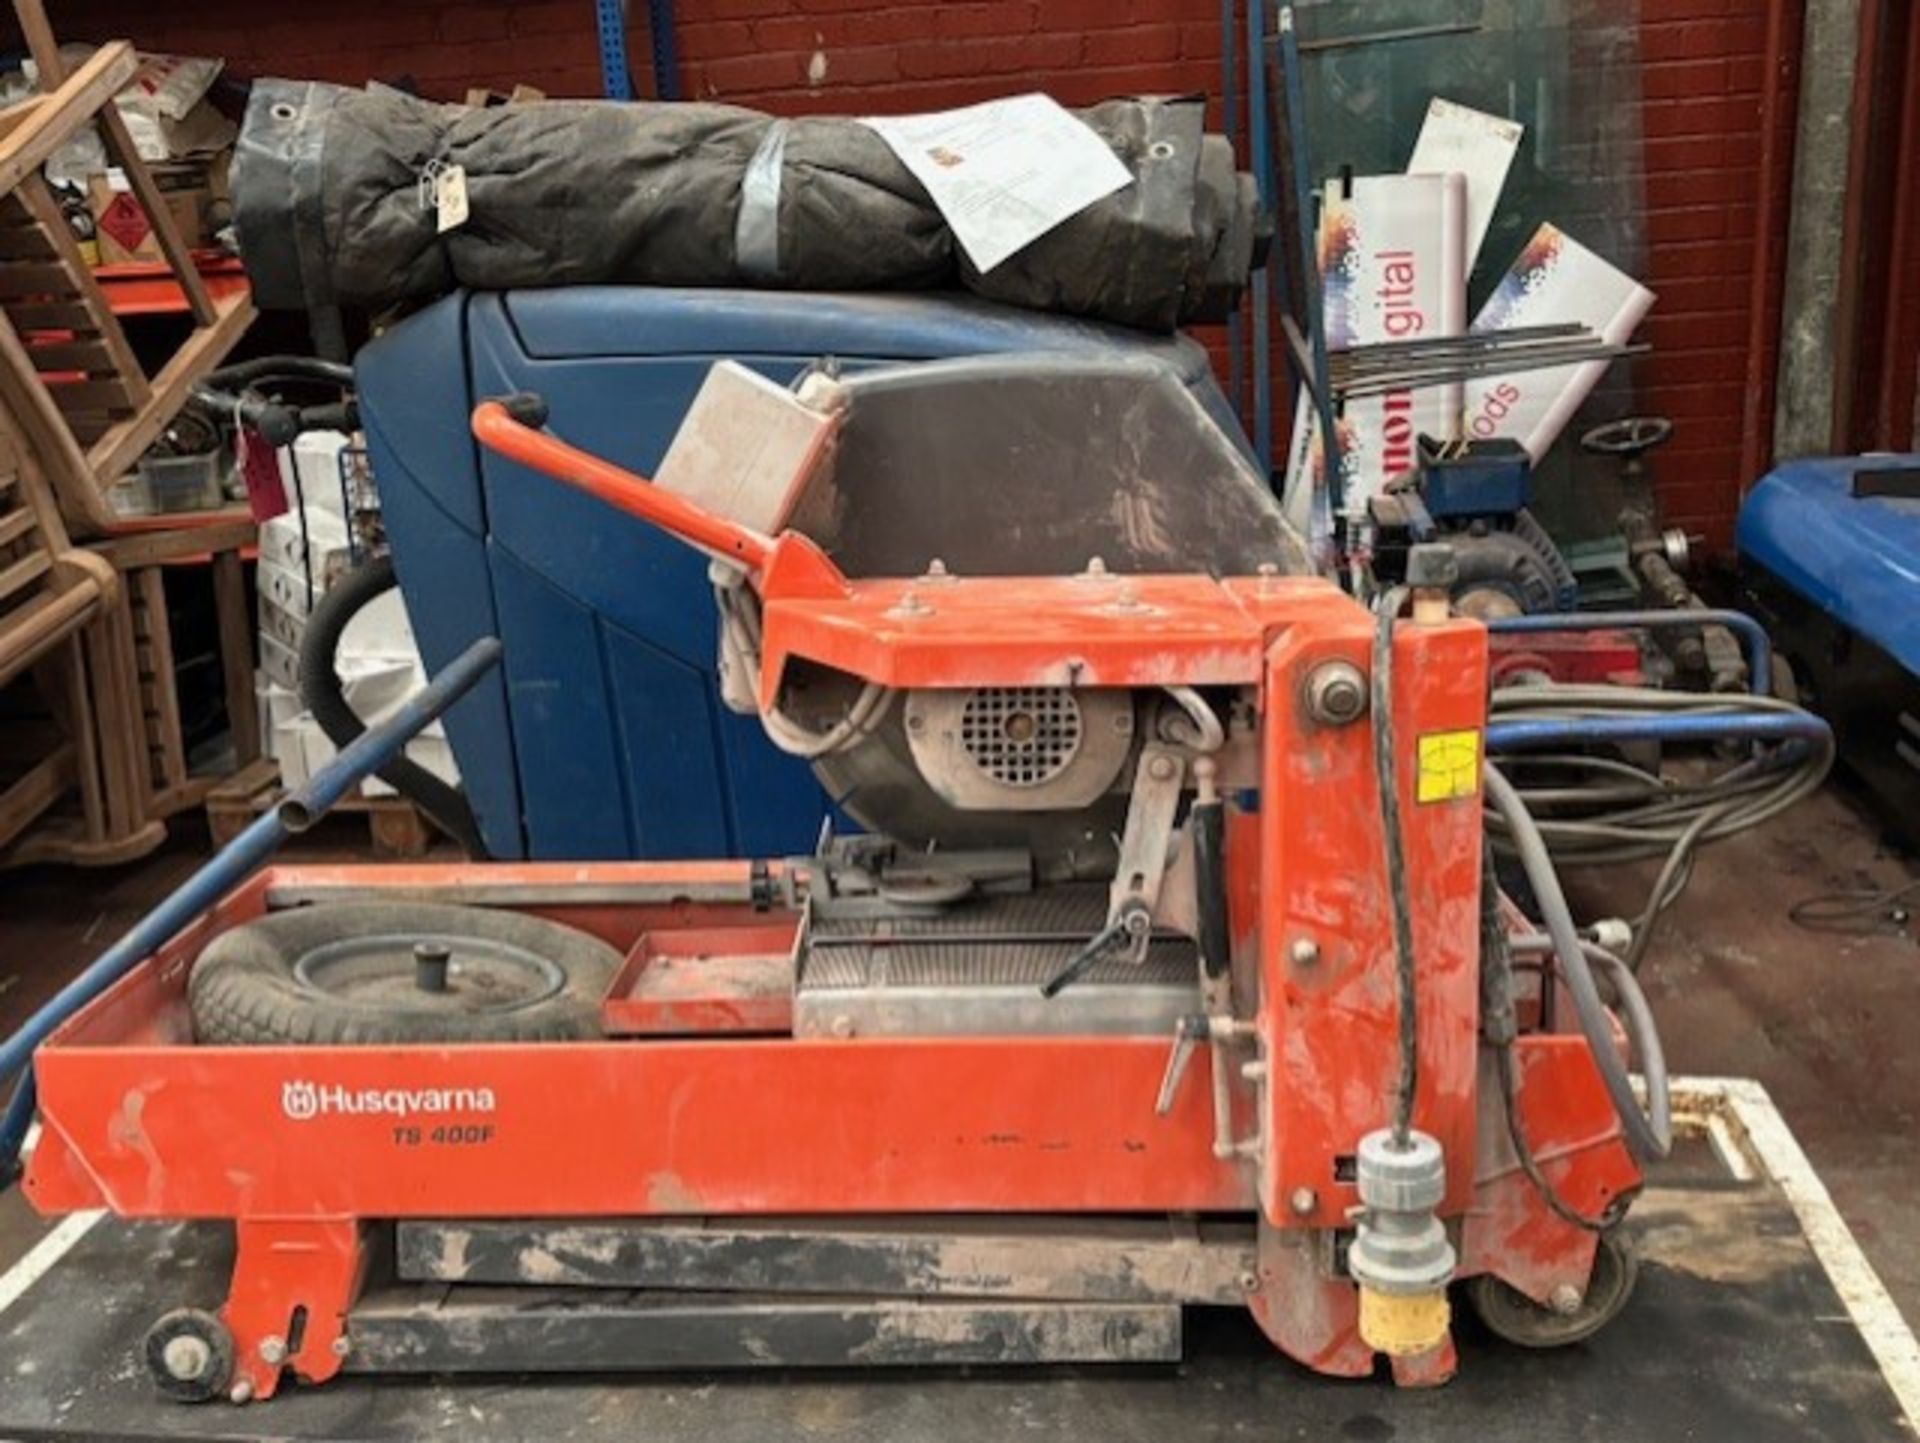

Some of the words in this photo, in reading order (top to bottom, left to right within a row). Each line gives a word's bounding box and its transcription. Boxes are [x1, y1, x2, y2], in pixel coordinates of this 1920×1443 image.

[1374, 251, 1423, 336] gital
[1382, 387, 1412, 473] non
[1472, 383, 1520, 436] ods
[319, 1084, 497, 1117] Husqvarna
